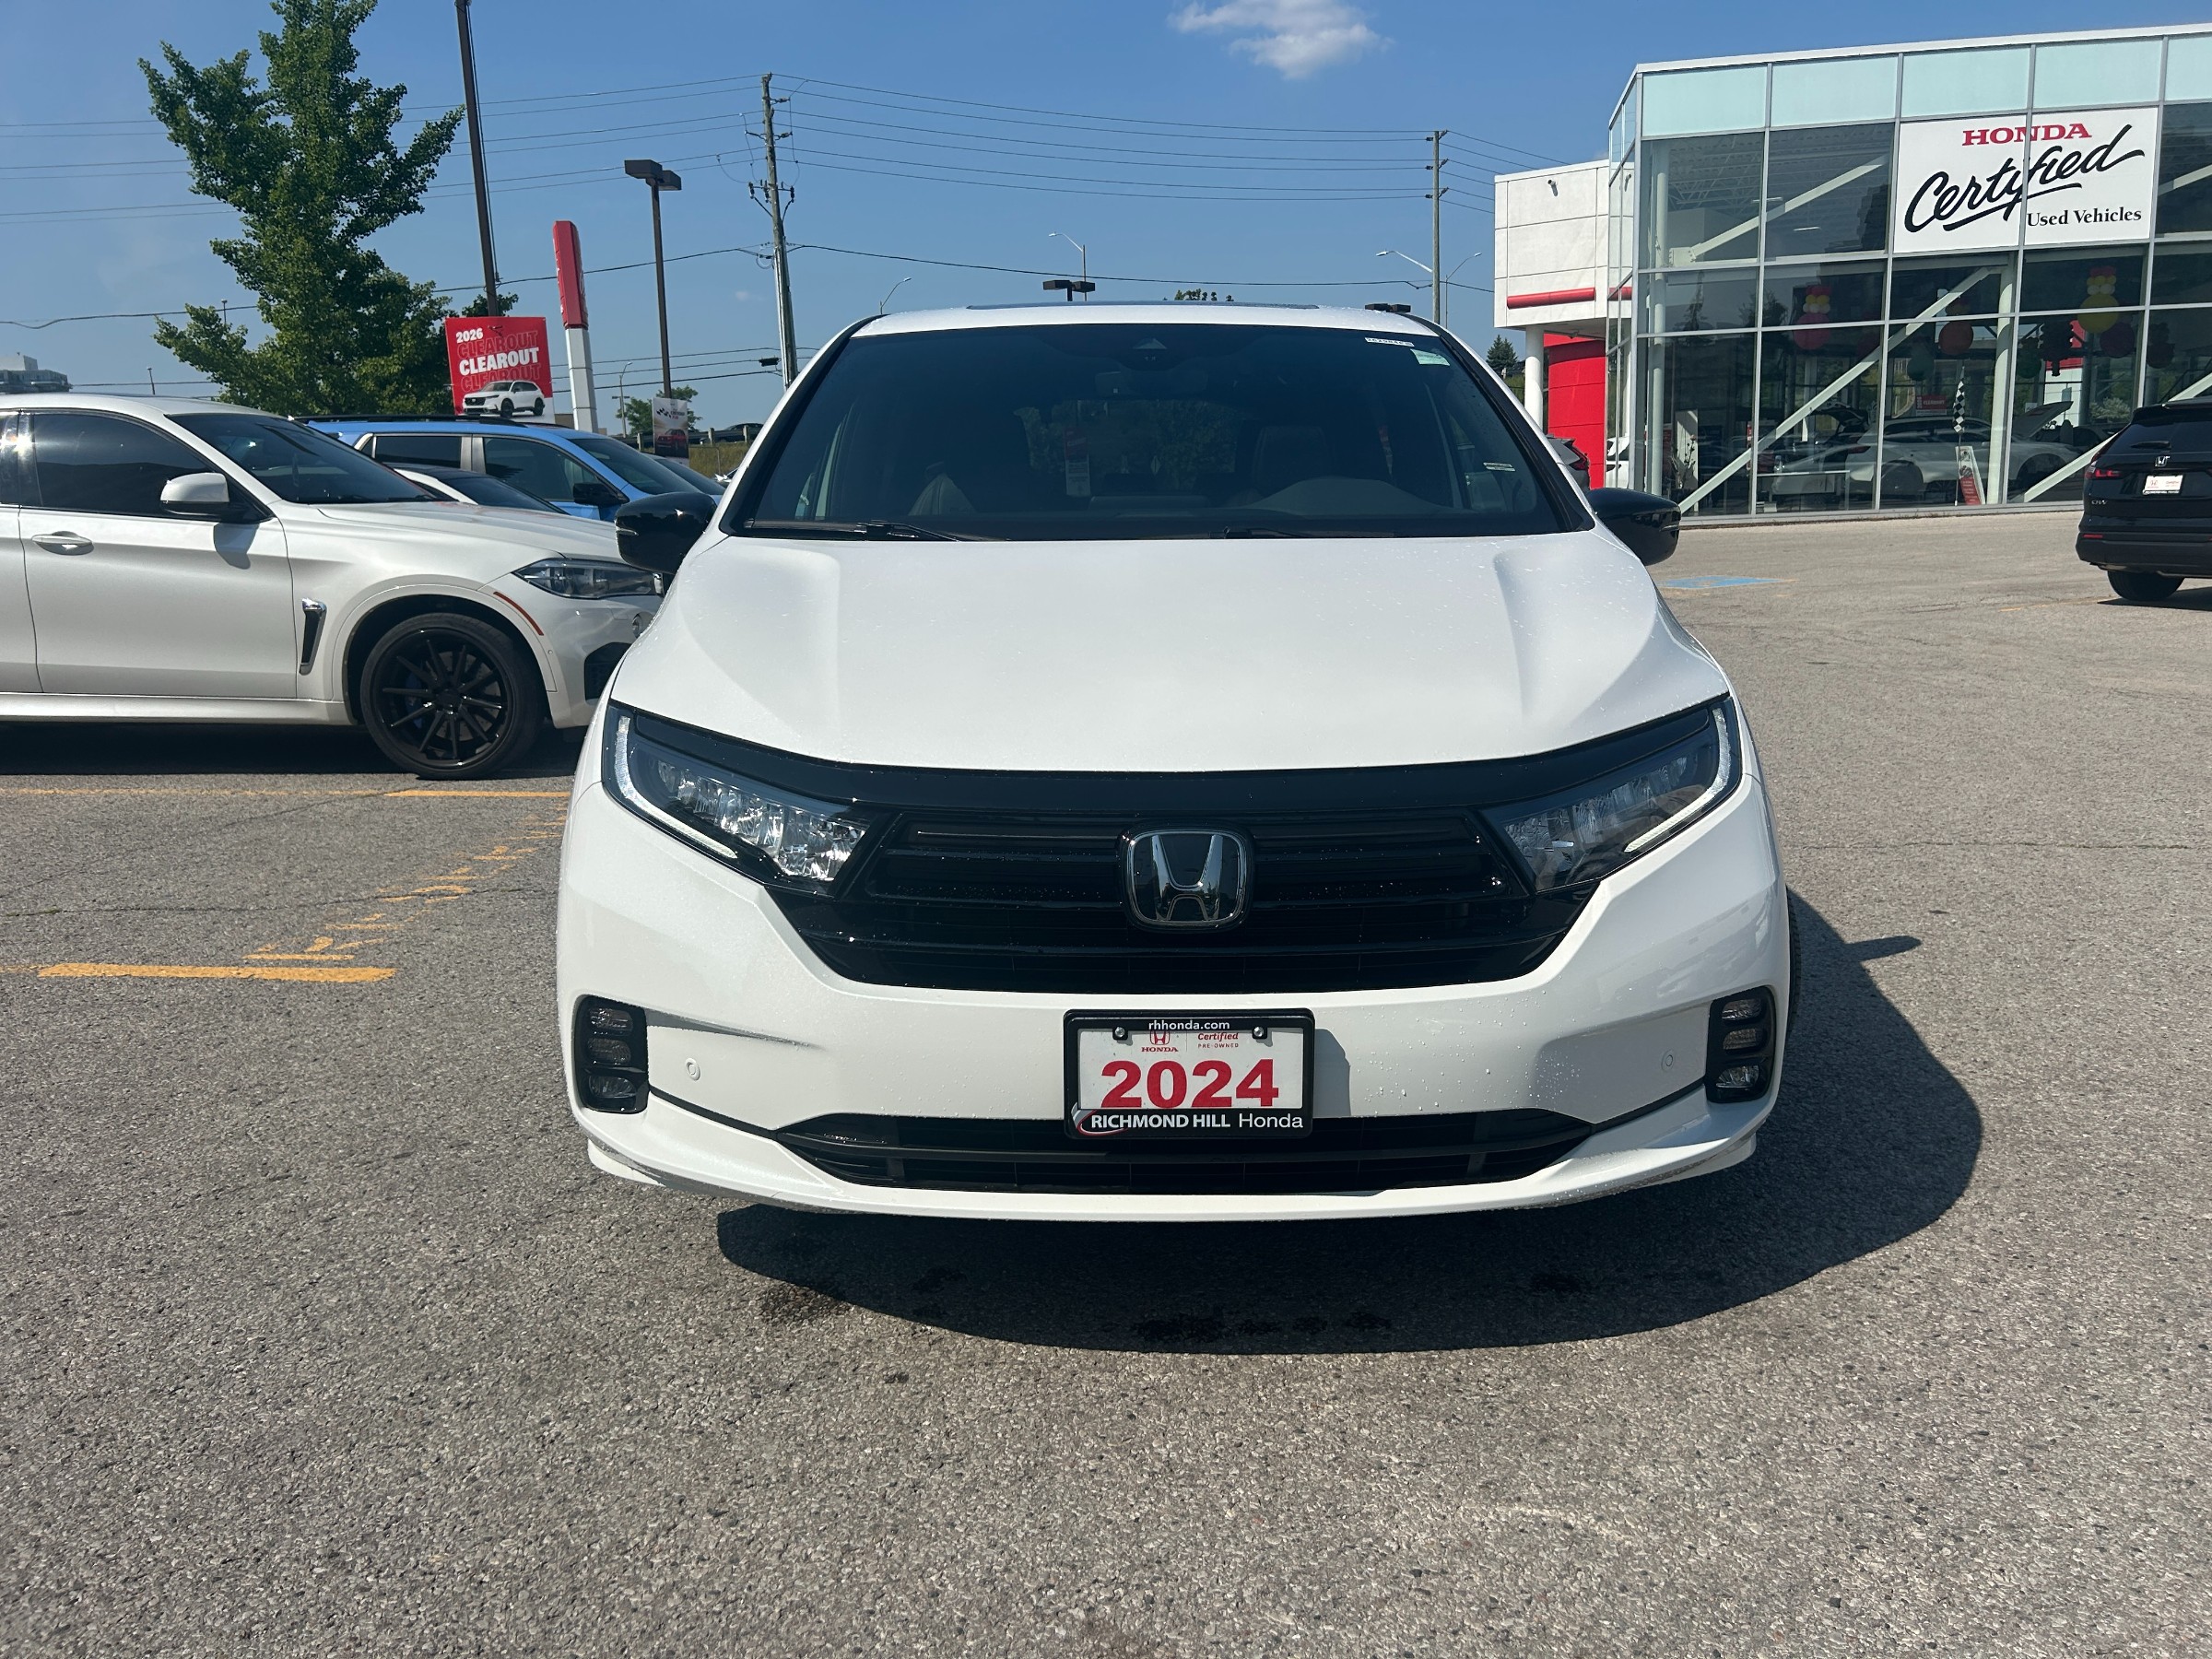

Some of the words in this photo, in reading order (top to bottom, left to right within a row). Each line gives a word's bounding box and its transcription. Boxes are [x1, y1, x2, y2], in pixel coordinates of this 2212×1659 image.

[1962, 123, 2092, 147] HONDA
[1904, 124, 2146, 232] Certified
[2027, 210, 2068, 227] Used
[2073, 206, 2142, 224] Vehicles
[455, 327, 484, 344] 2026
[456, 330, 539, 360] CLEAROUT
[459, 347, 539, 376] CLEAROUT
[1148, 1019, 1230, 1030] rhhonda.com
[1197, 1031, 1240, 1041] Certified
[1100, 1058, 1279, 1109] 2024
[1091, 1113, 1189, 1128] RICHMOND
[1193, 1113, 1230, 1128] HILL
[1239, 1112, 1303, 1128] Honda
